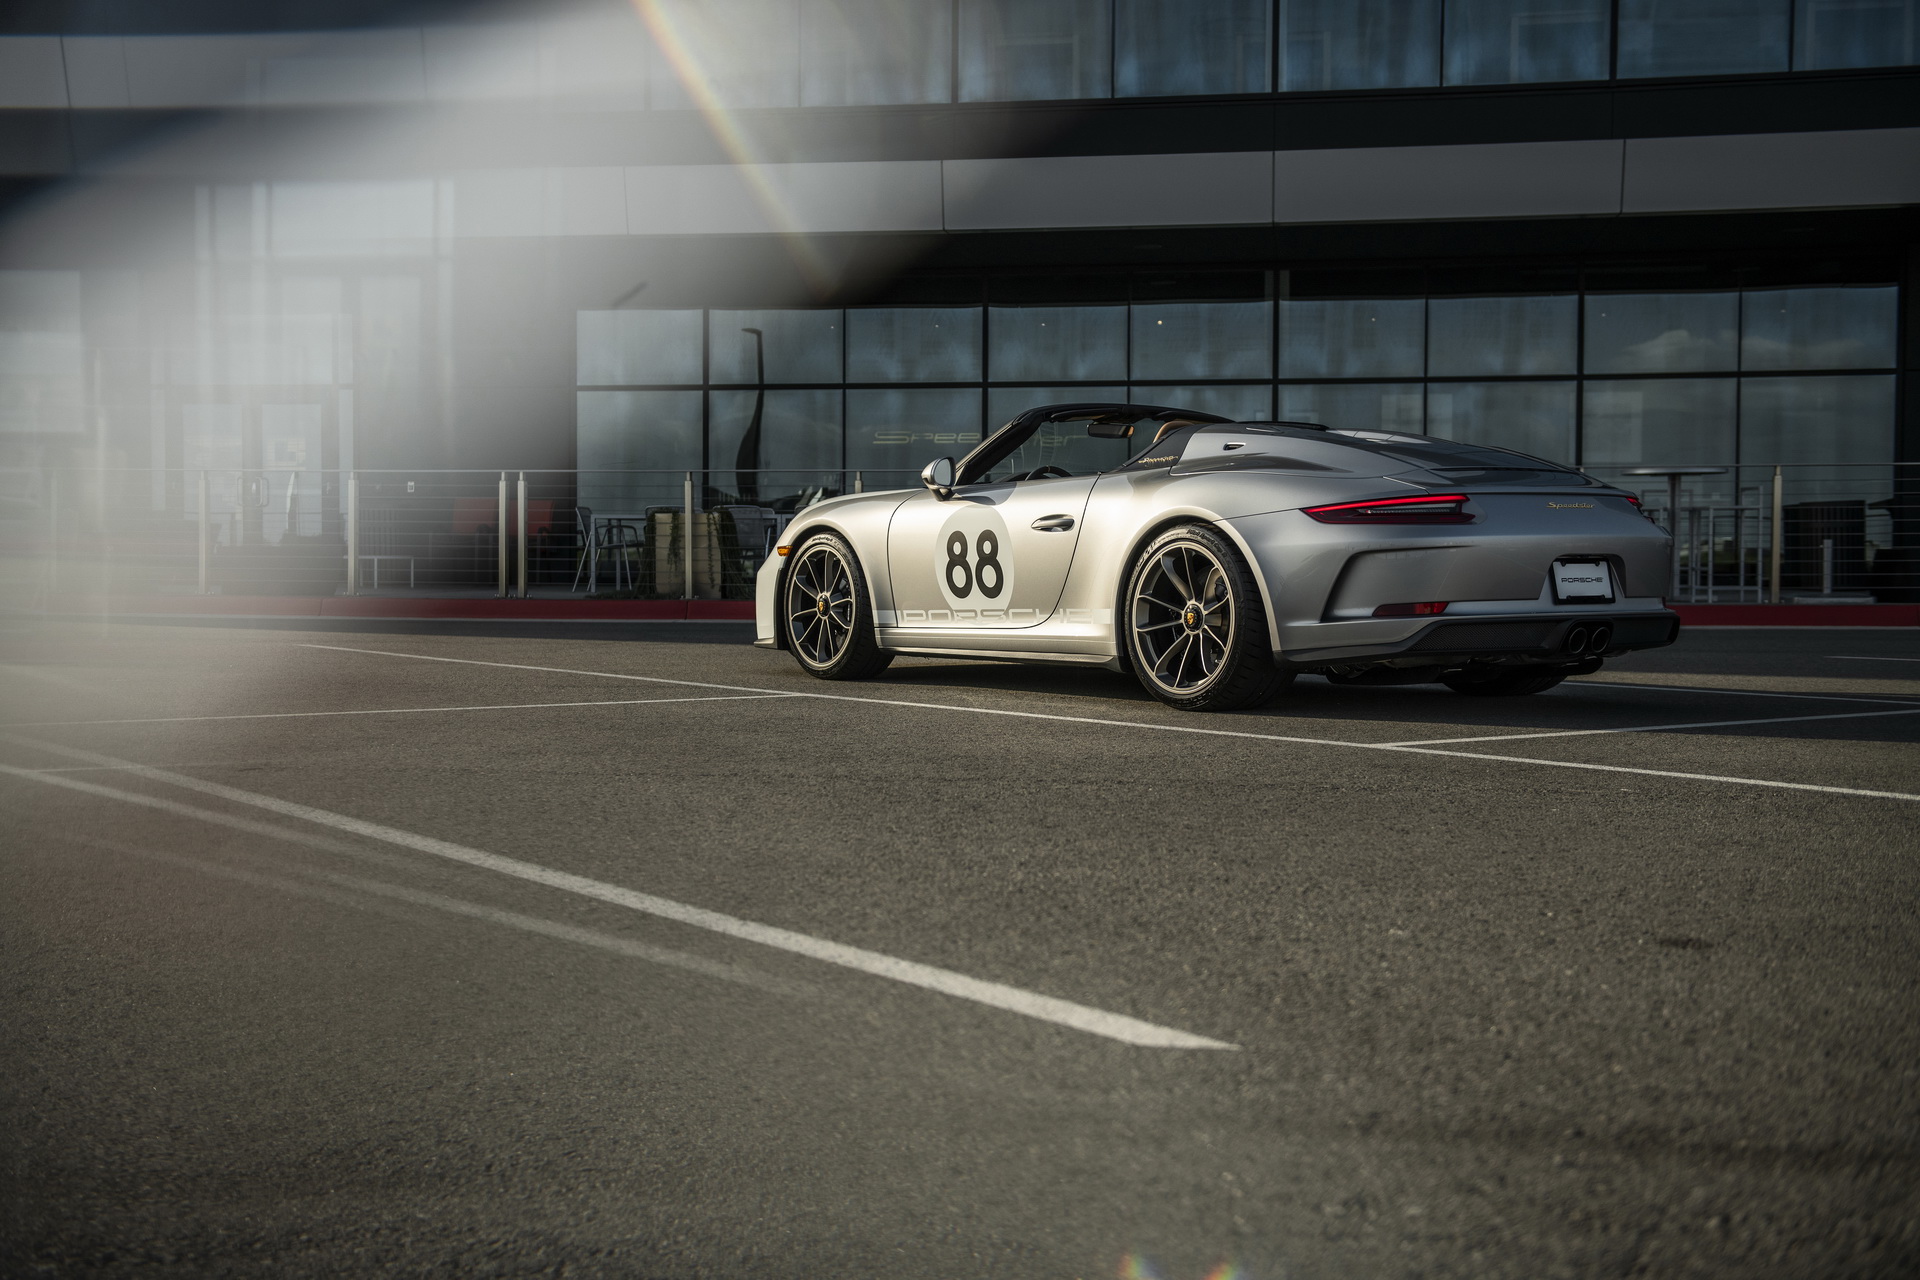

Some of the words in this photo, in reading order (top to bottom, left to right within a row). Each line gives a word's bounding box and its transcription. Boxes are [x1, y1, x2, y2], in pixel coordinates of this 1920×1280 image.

[1546, 501, 1595, 510] Speedster
[945, 528, 1004, 599] 88
[1561, 576, 1603, 584] PORSCHE
[902, 608, 1093, 625] PORSCHE
